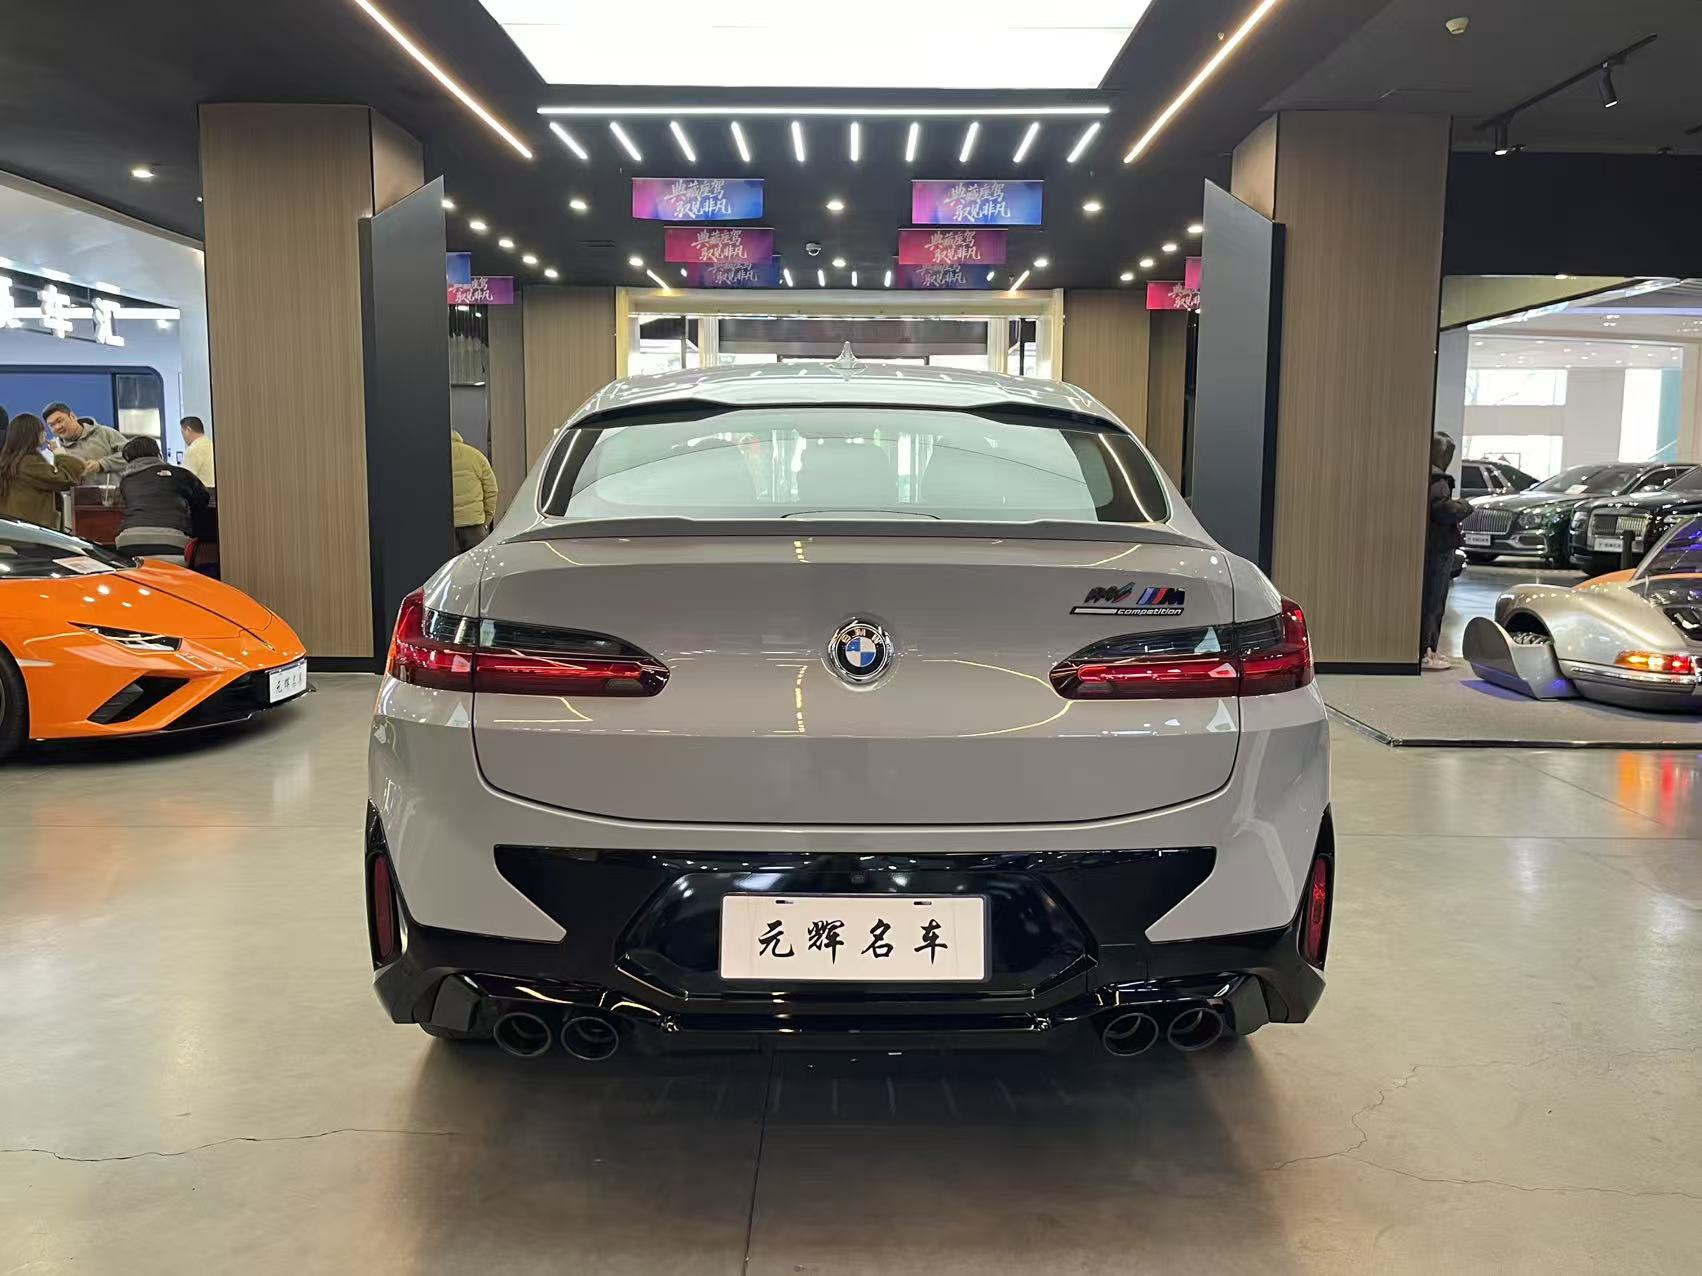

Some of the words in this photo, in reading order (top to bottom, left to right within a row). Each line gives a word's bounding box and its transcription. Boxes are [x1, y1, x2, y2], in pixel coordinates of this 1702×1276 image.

[664, 180, 725, 203] 典藏座驾
[944, 182, 1005, 206] 典藏座驾
[674, 199, 731, 218] 驭见非凡
[953, 201, 1010, 222] 驭见非凡
[691, 229, 742, 249] 典藏座驾
[924, 231, 976, 250] 典藏座驾
[1117, 608, 1182, 616] competition
[758, 918, 948, 965] 元辉名车
